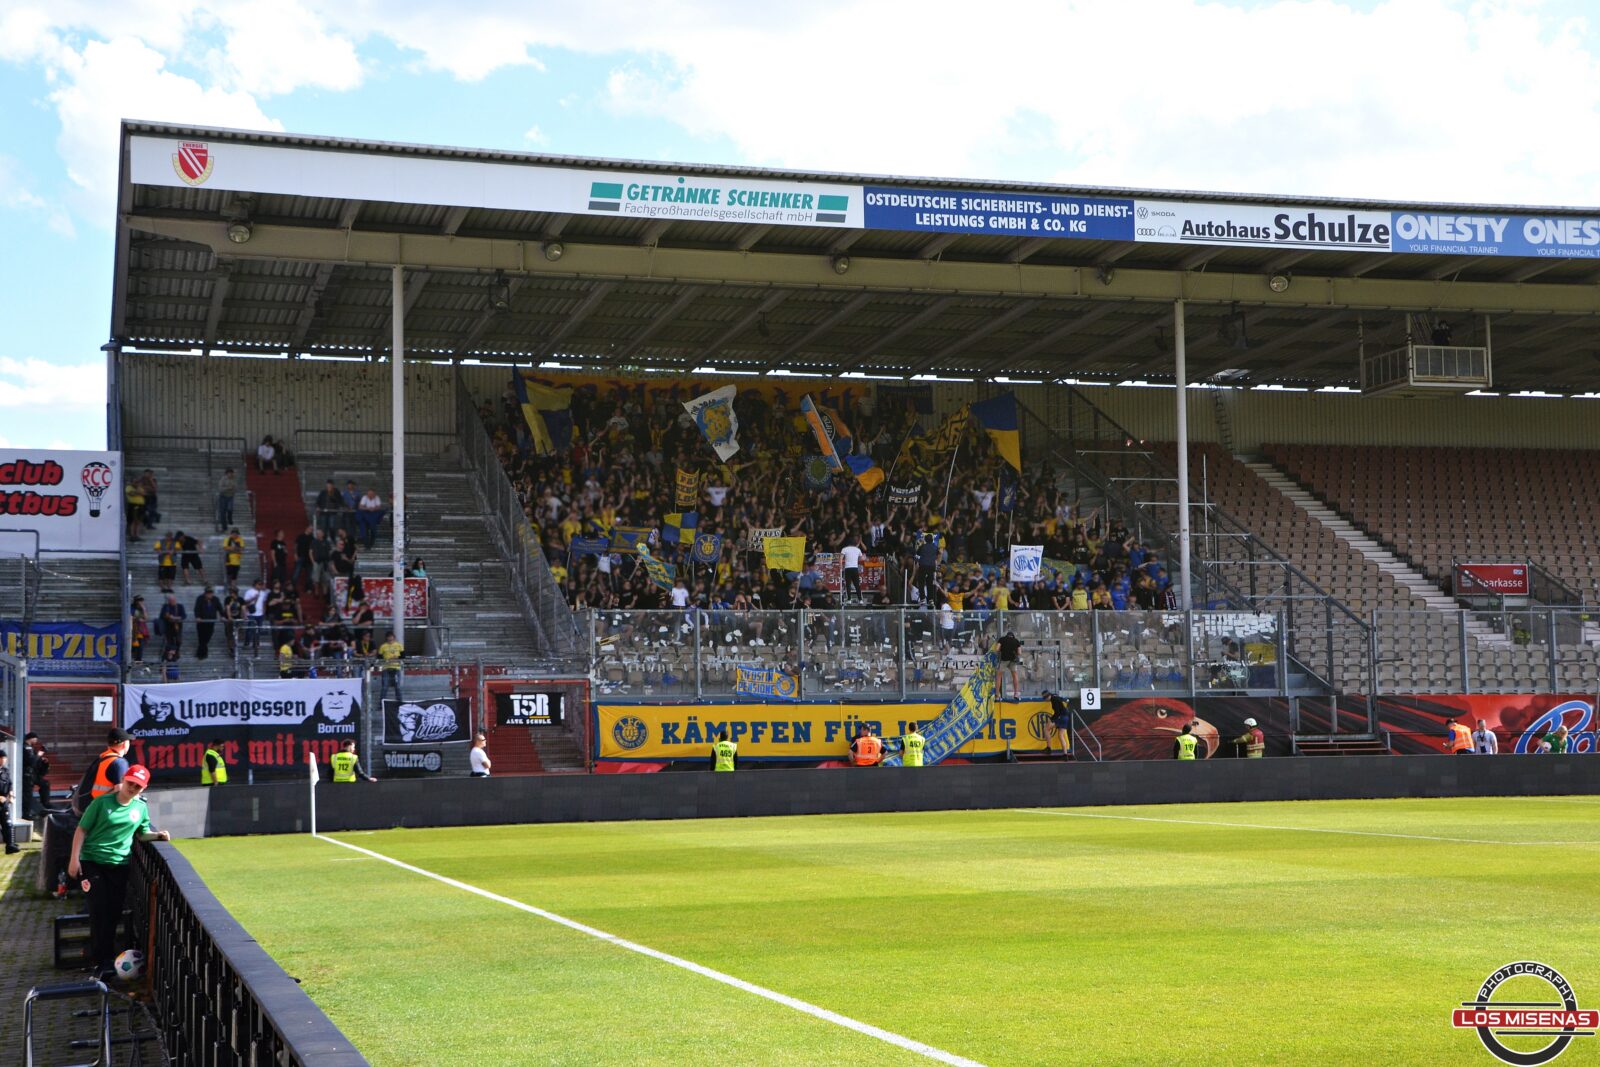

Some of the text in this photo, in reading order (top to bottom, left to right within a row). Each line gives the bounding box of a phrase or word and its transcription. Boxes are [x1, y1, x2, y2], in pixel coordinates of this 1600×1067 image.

[727, 189, 813, 210] SCHENKER
[866, 193, 1133, 218] OSTDEUTSCHE SICHERHEITS- UND DIENST-
[624, 203, 812, 222] Fachgroßhandelsgesellschaft mbH
[915, 213, 1087, 233] LEISTUNGS GMBH & CO. KG
[1182, 212, 1390, 244] Autohaus Schulze
[1396, 214, 1509, 242] ONESTY
[1523, 218, 1600, 246] ONES
[1409, 244, 1498, 254] YOUR FINANCIAL TRAINER
[1536, 247, 1556, 256] YOUR
[1558, 248, 1595, 257] FINANCIAL
[82, 468, 111, 486] RCC
[0, 631, 118, 658] EIPZIG
[1086, 691, 1094, 706] 9
[99, 701, 107, 717] 7
[179, 699, 307, 721] Unvergessen
[132, 727, 189, 737] Schalke Micha
[317, 722, 355, 734] Borrmi
[661, 716, 812, 744] KÄMPFEN
[133, 738, 239, 769] Immr
[249, 732, 295, 765] mit
